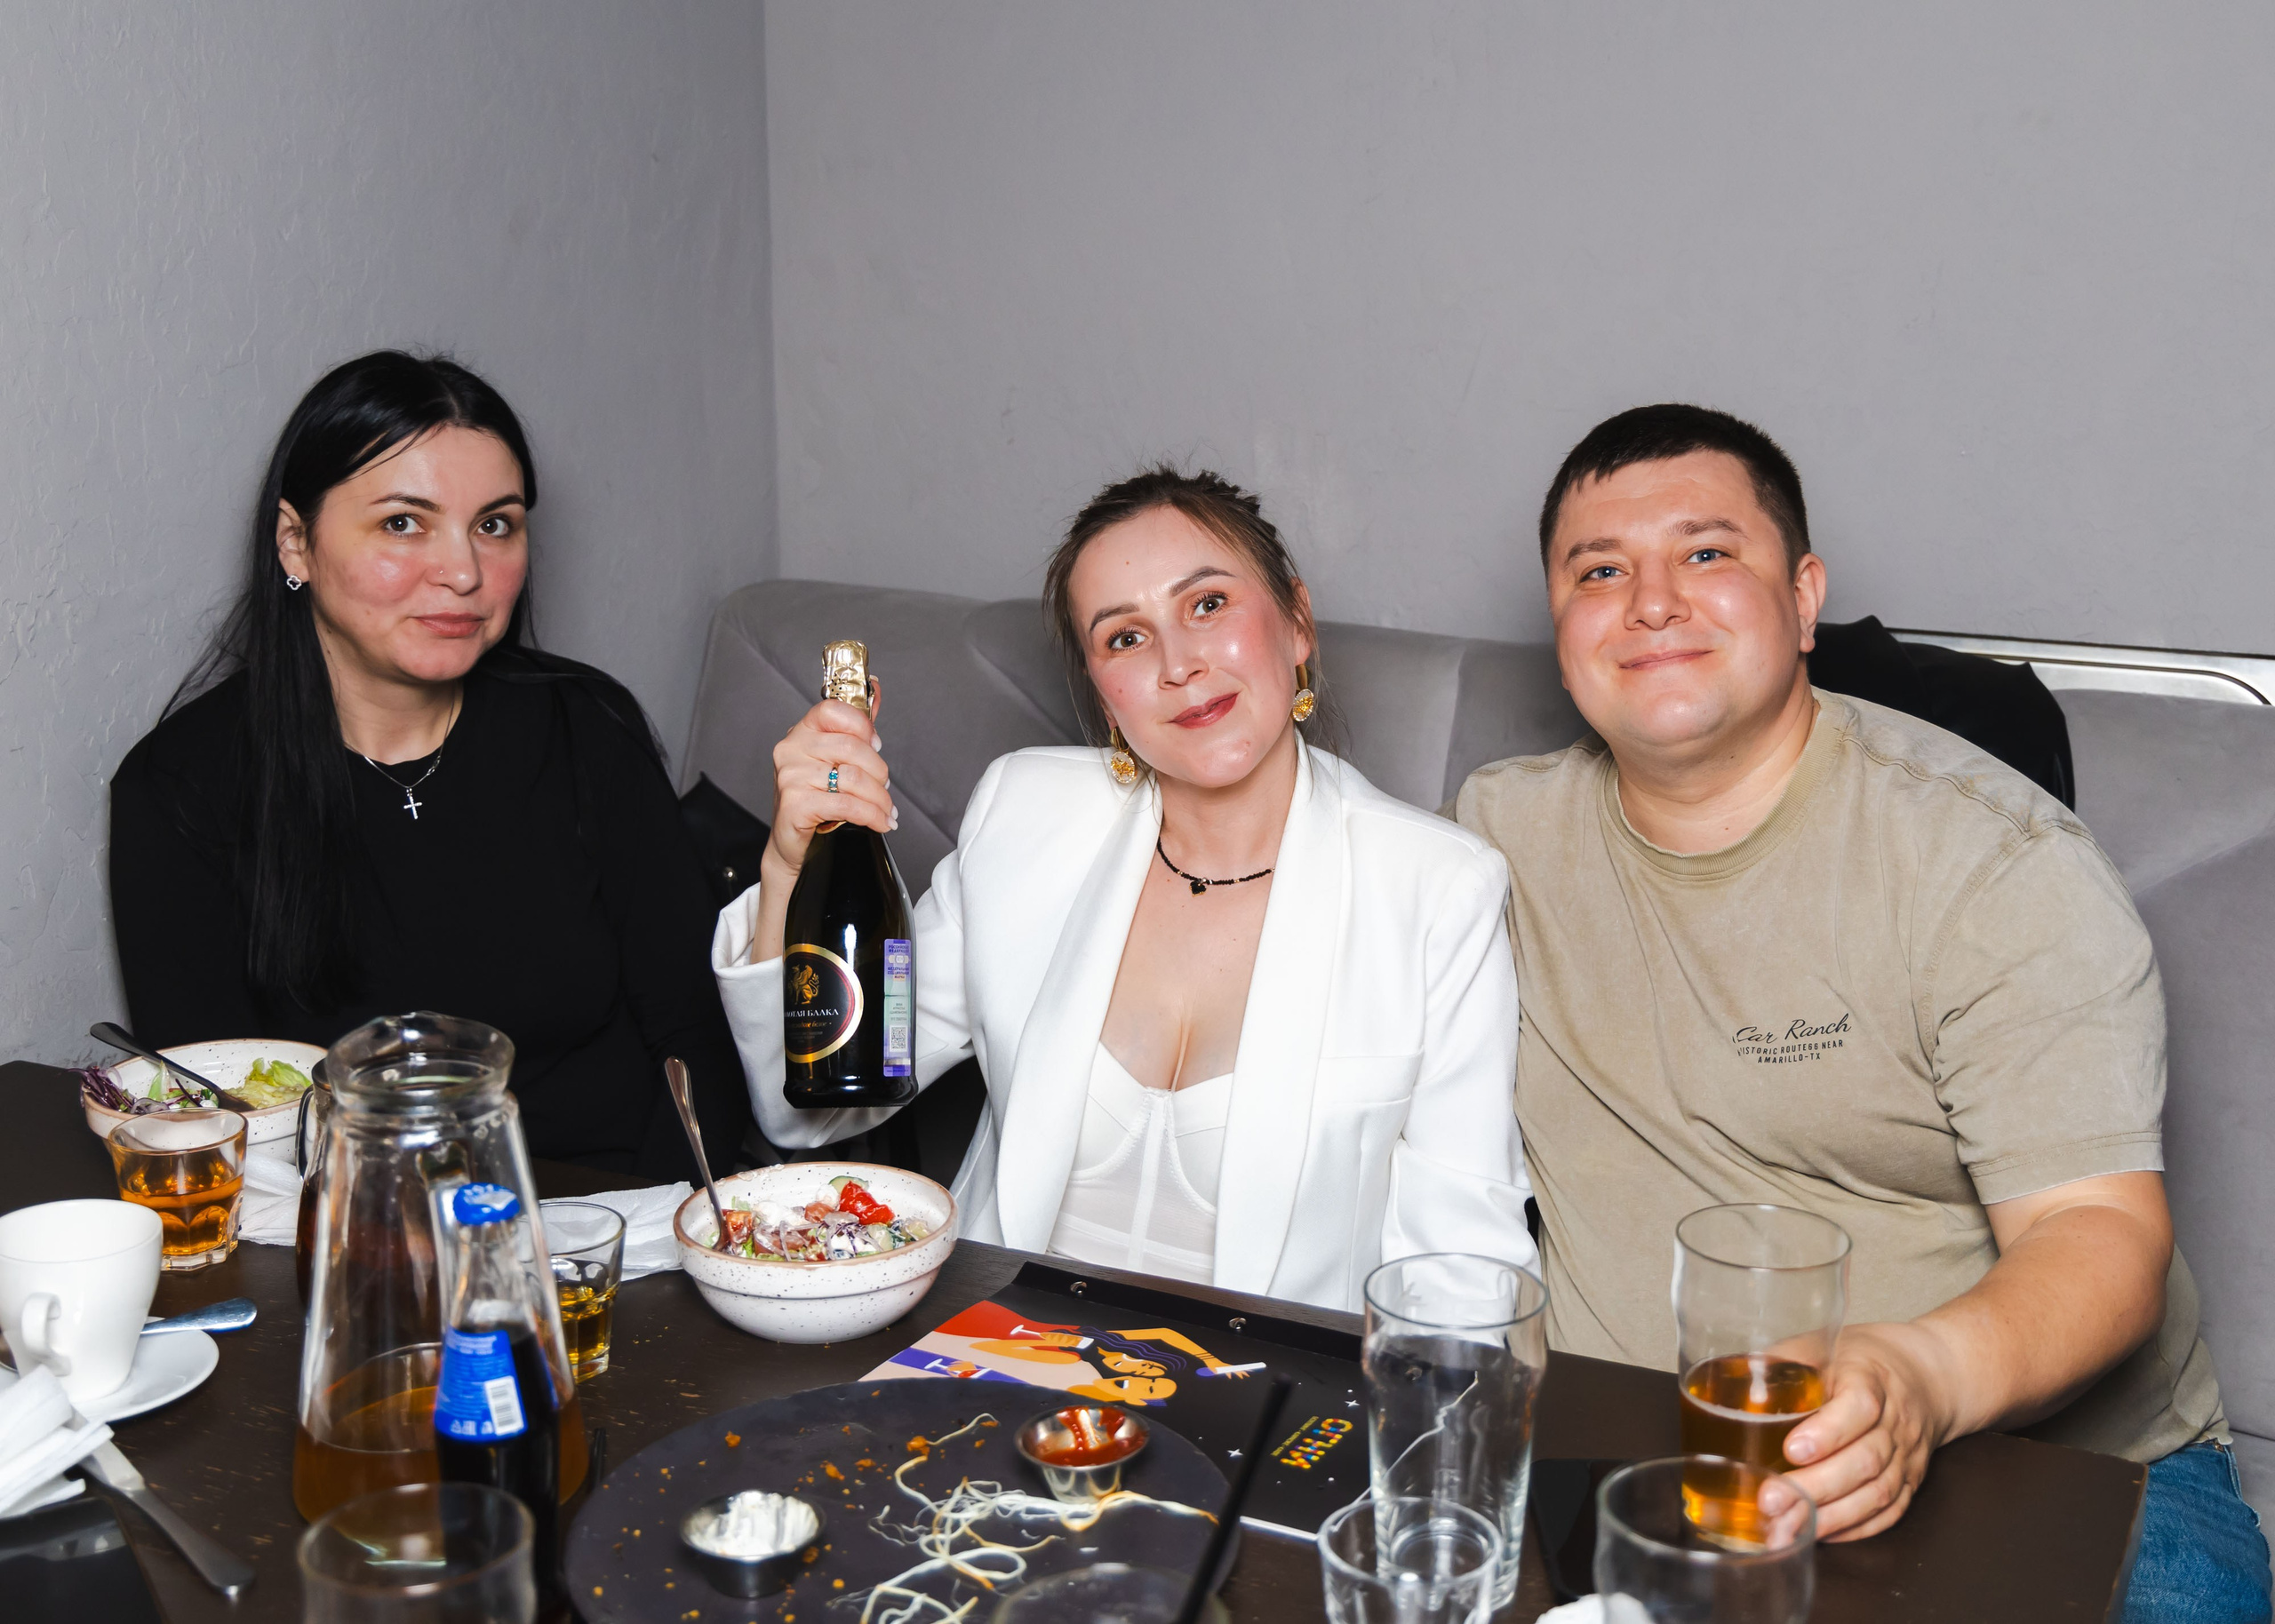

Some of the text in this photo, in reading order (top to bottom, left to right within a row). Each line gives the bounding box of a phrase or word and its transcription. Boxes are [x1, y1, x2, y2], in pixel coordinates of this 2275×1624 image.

[1732, 1013, 1851, 1044] Car Ranch
[1822, 1039, 1843, 1049] NEAR
[1758, 1052, 1820, 1063] AMARILLO-TX
[1280, 1418, 1353, 1469] ОГНИ
